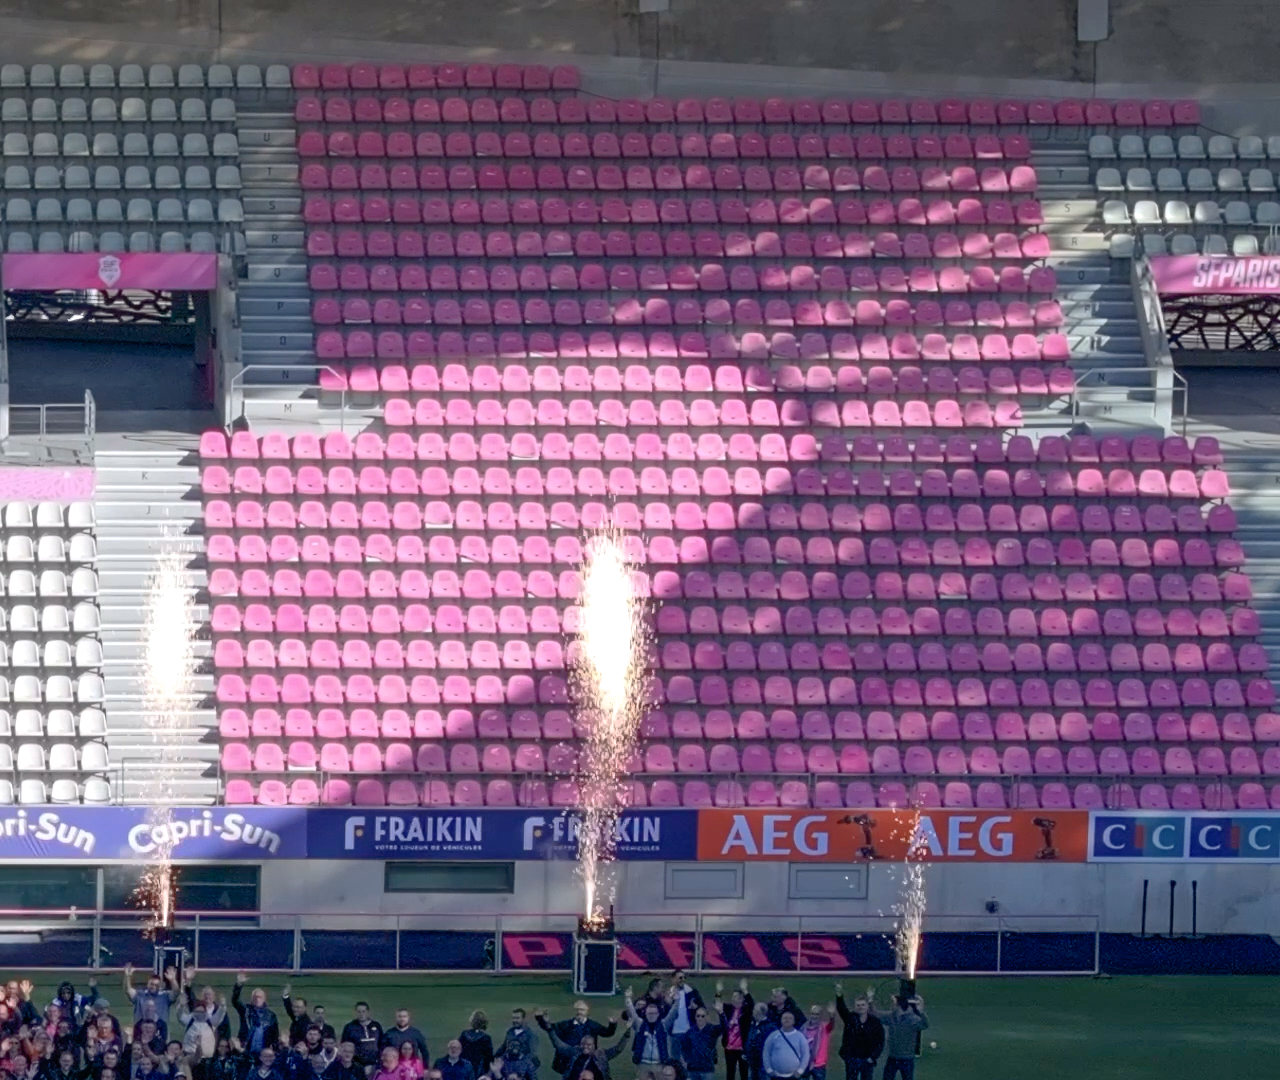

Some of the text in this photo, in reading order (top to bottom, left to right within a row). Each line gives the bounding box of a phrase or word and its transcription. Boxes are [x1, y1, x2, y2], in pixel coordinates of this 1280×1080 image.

[128, 811, 281, 854] Capri-Sun
[375, 816, 482, 842] FRAIKIN
[721, 815, 829, 855] AEG
[906, 815, 1013, 856] AEG
